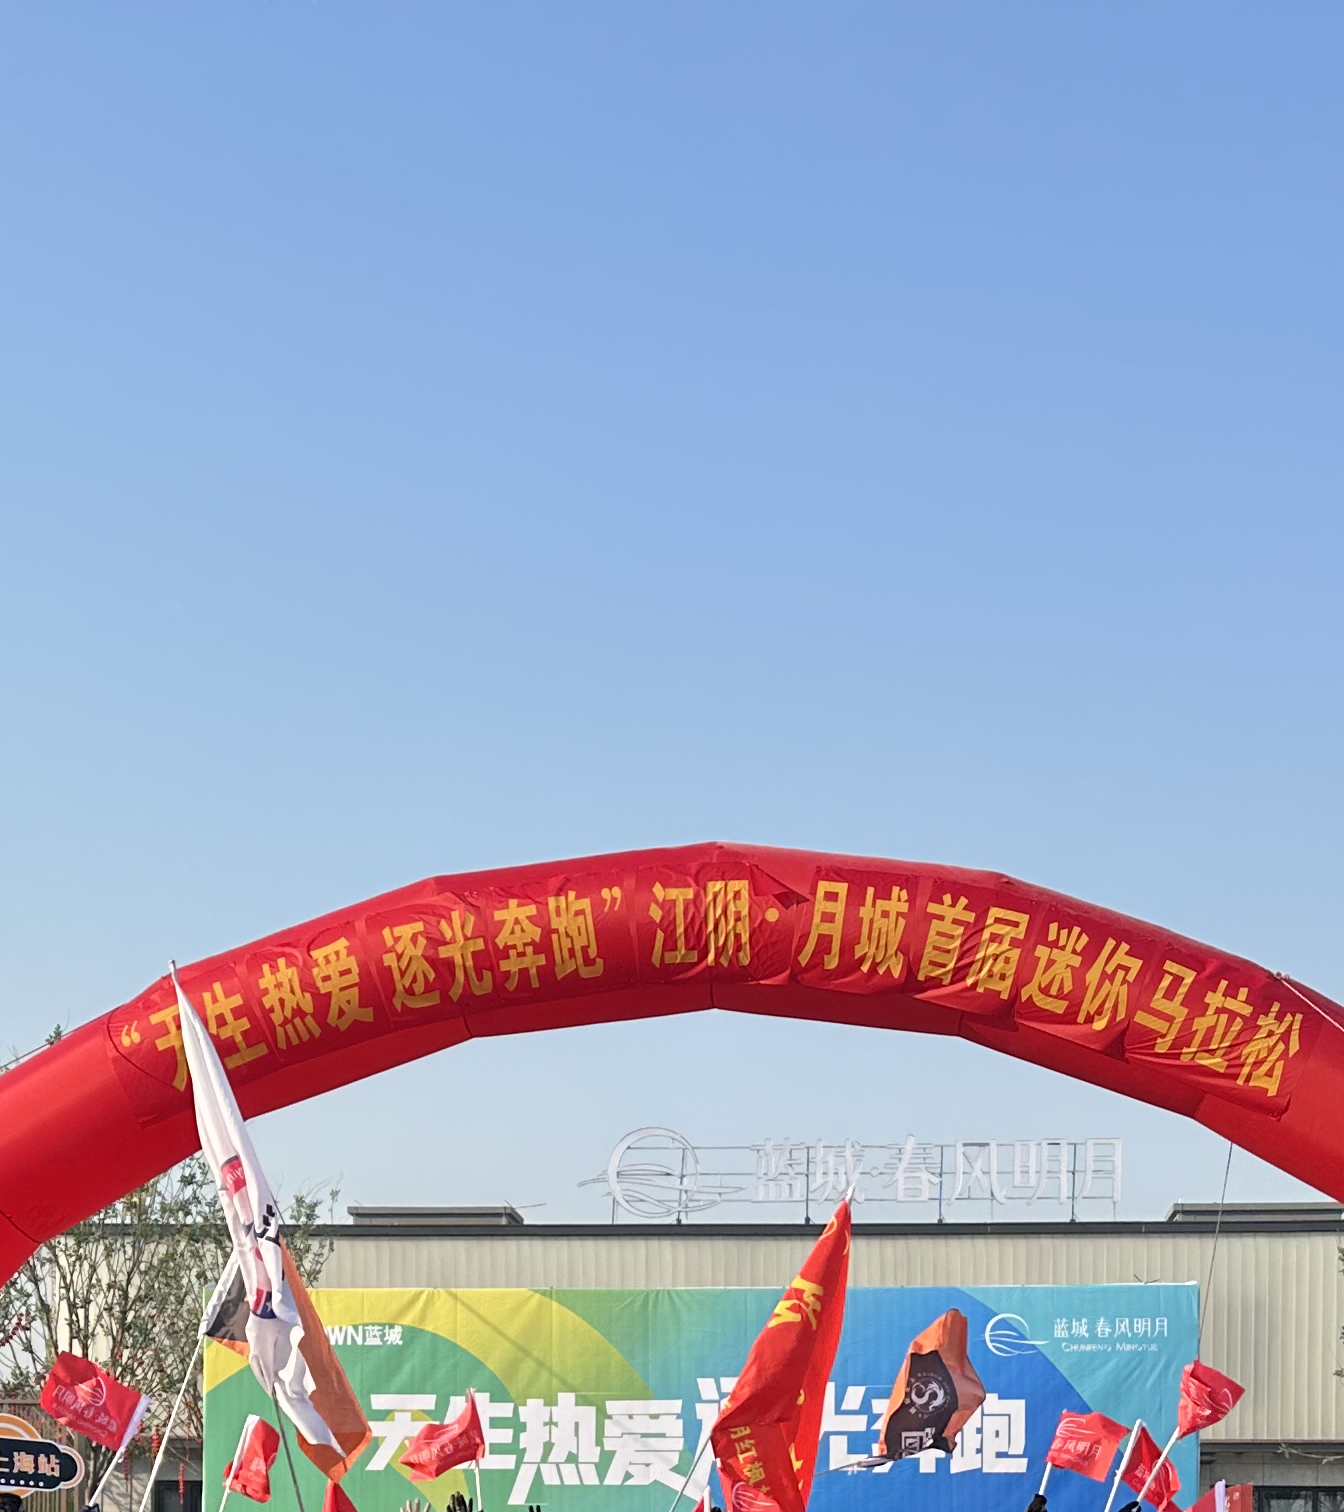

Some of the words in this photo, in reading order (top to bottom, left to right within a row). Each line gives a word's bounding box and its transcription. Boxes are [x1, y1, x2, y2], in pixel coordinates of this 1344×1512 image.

[382, 885, 622, 1011] 逐光奔跑”
[1096, 1316, 1168, 1339] 春风明月
